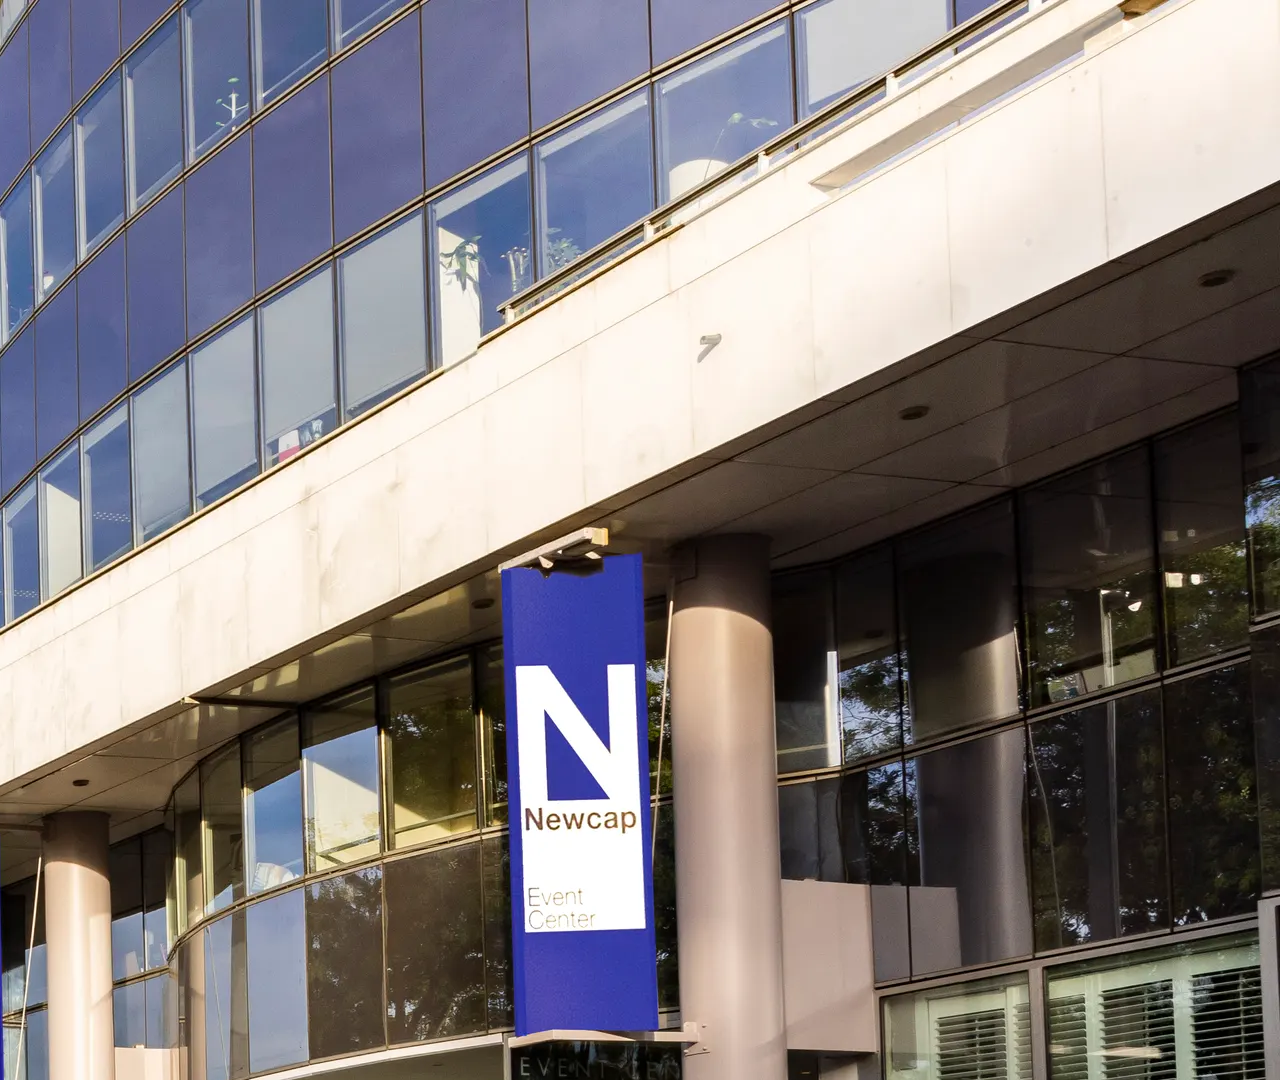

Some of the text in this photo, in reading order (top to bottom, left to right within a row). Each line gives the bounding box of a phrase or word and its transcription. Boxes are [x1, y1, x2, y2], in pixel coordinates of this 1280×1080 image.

[516, 664, 639, 801] N
[525, 808, 637, 834] Newcap
[528, 887, 583, 907] Event
[528, 909, 596, 930] Center
[520, 1056, 608, 1079] EVENT
